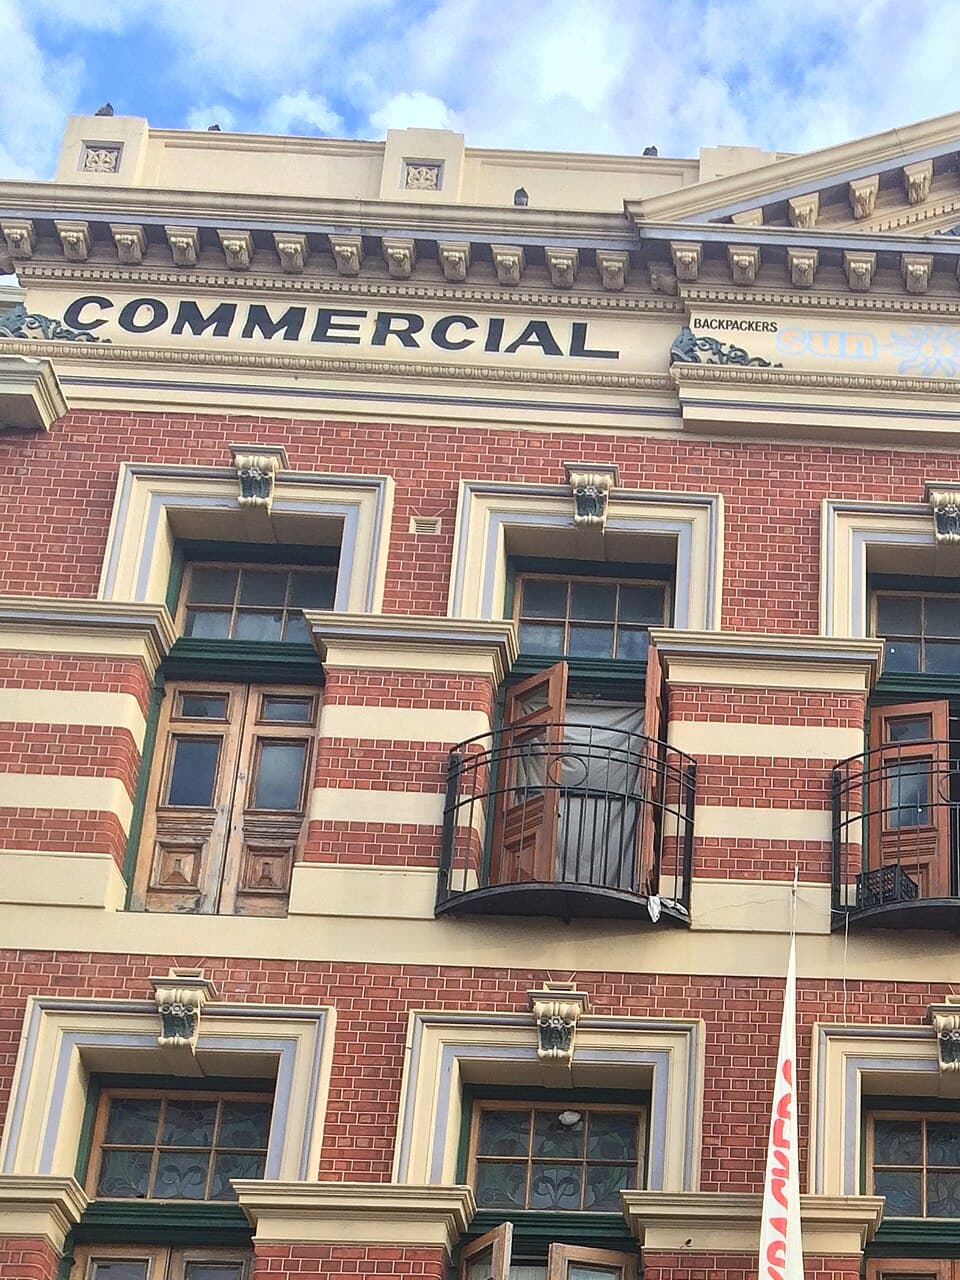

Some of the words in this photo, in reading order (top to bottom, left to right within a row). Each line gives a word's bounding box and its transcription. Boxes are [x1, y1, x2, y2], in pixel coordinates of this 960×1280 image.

[63, 295, 621, 360] COMMERCIAL
[693, 318, 779, 333] BACKPACKERS
[776, 327, 877, 360] sun
